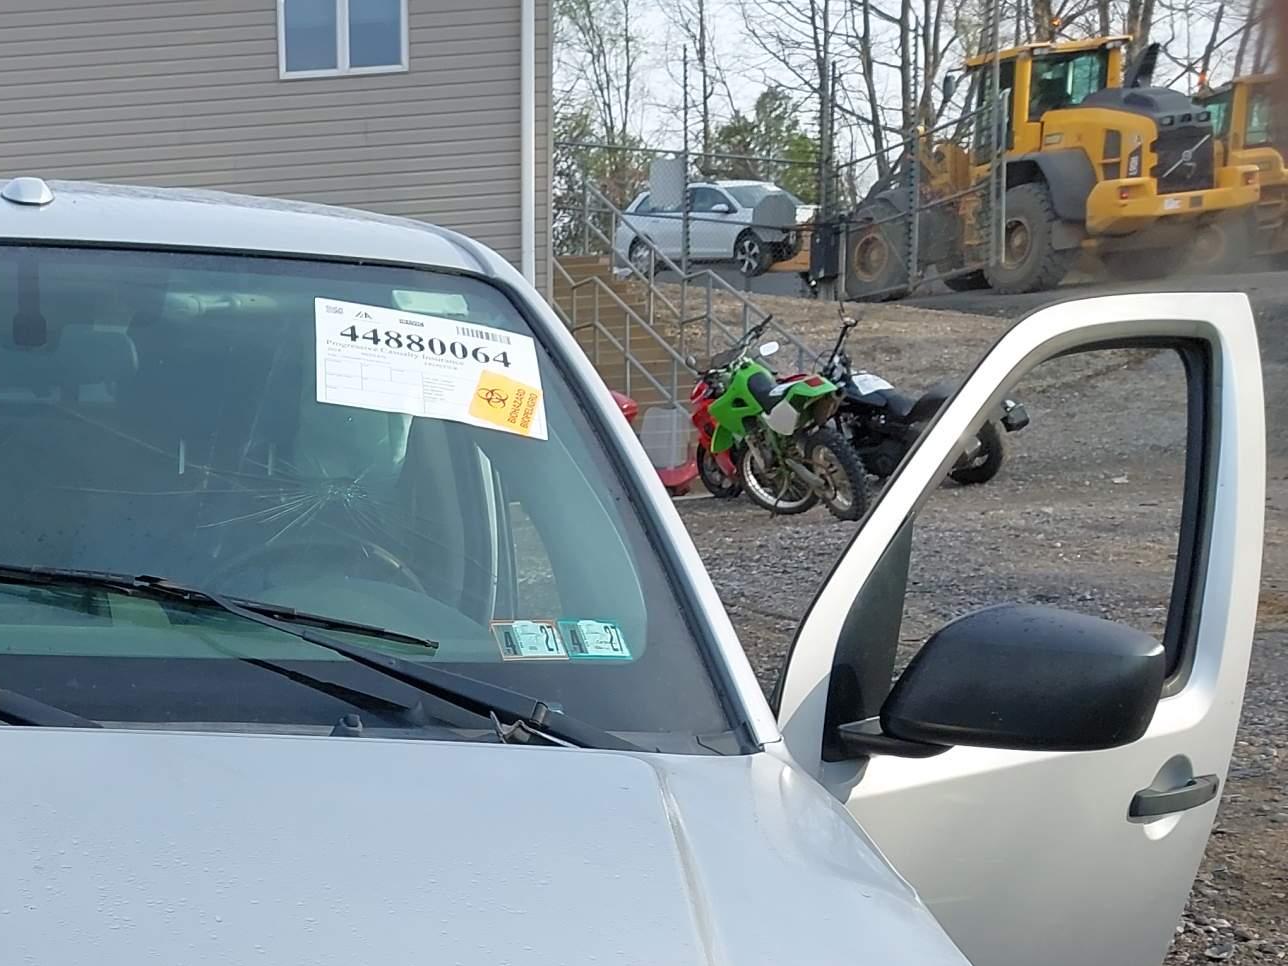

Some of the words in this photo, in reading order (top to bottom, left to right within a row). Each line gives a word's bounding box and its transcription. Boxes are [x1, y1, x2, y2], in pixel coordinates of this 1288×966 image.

[339, 324, 512, 368] 44880064
[506, 388, 527, 425] BIOHAZARD
[519, 392, 539, 430] BIOPELIGRO
[503, 631, 517, 656] 4
[539, 624, 560, 653] 27
[604, 624, 624, 653] 27
